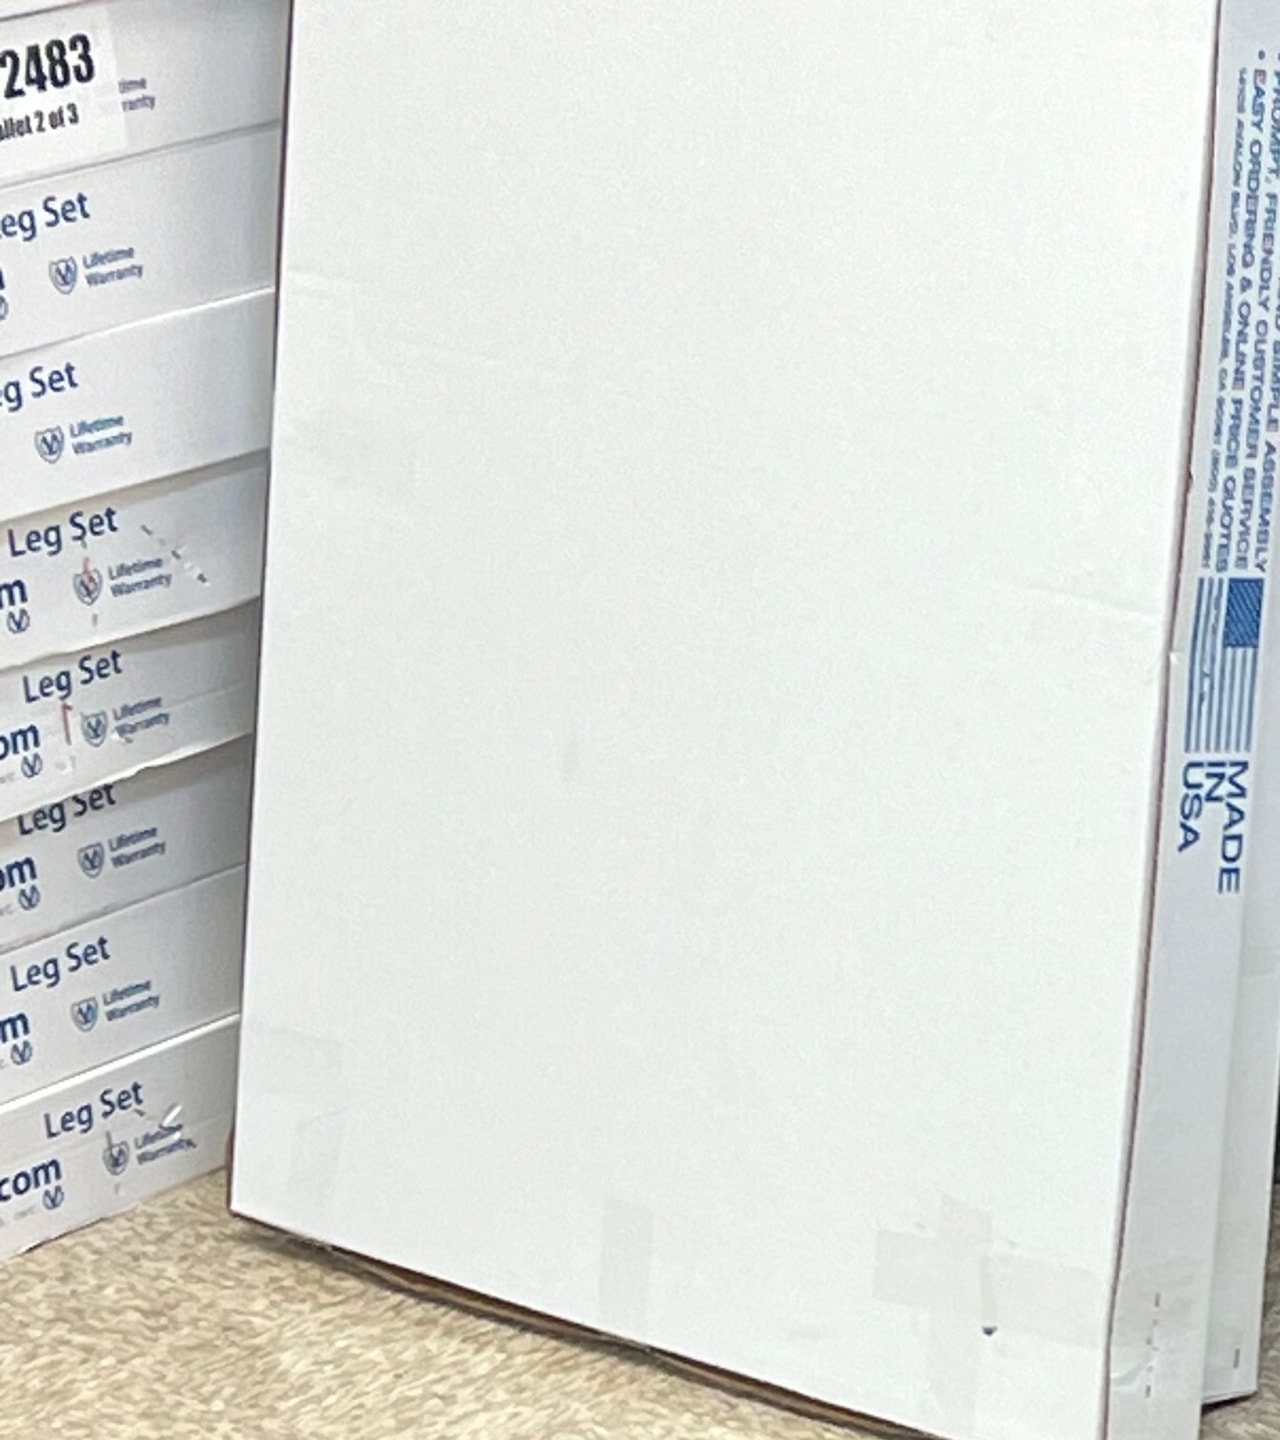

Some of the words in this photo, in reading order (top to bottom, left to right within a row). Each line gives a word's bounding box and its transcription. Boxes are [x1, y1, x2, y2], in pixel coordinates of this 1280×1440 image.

[0, 33, 95, 99] 2483
[34, 109, 46, 133] 2
[48, 105, 66, 130] of
[67, 102, 79, 125] 3
[1250, 69, 1266, 132] EASY
[0, 208, 37, 242] eg
[43, 191, 91, 228] Set
[1241, 139, 1263, 269] ORDERING
[82, 246, 136, 271] Lifetime
[86, 262, 144, 289] Warranty
[1258, 192, 1278, 312] FRIENDLY
[1239, 277, 1253, 294] &
[1231, 301, 1252, 390] ONLINE
[29, 361, 79, 398] Set
[1246, 319, 1269, 459] CUSTOMER
[69, 415, 125, 438] Lifetime
[72, 430, 134, 456] Warranty
[1225, 397, 1244, 469] PRICE
[8, 523, 63, 558] Leg
[69, 506, 119, 541] Set
[1215, 475, 1237, 573] QUOTES
[1234, 467, 1257, 570] SERVICE
[1254, 441, 1277, 573] ASSEMBLY
[108, 557, 164, 581] Lifetime
[110, 573, 173, 598] Warranty
[23, 669, 73, 703] Leg
[79, 649, 123, 686] Set
[112, 697, 163, 721] Lifetime
[114, 712, 170, 736] Warranty
[1177, 760, 1205, 853] USA
[1204, 761, 1227, 803] IN
[17, 800, 66, 835] Leg
[73, 783, 117, 818] Set
[1217, 760, 1249, 894] MADE
[108, 826, 158, 851] Lifetime
[110, 841, 167, 868] Warranty
[10, 956, 61, 992] Leg
[65, 935, 112, 972] Set
[102, 979, 152, 1004] Lifetime
[105, 993, 161, 1022] Warranty
[43, 1102, 94, 1139] Leg
[100, 1081, 145, 1119] Set
